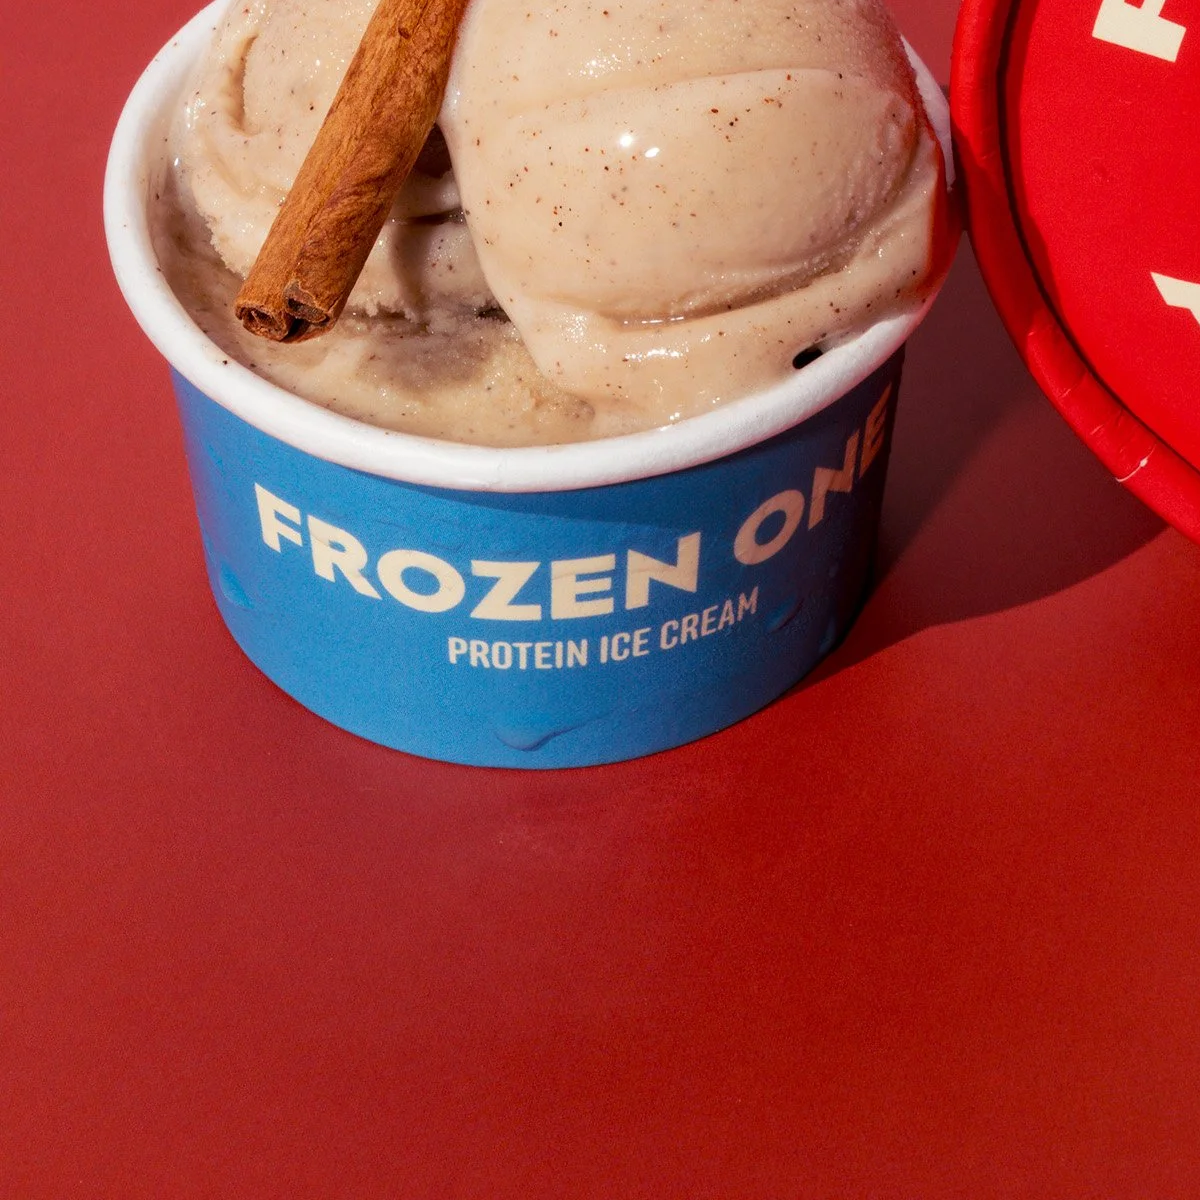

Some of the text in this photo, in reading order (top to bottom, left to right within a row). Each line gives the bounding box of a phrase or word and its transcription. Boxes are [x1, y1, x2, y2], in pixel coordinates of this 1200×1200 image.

[253, 382, 893, 623] FROZEN ONE
[447, 587, 760, 672] PROTEIN ICE CREAM
